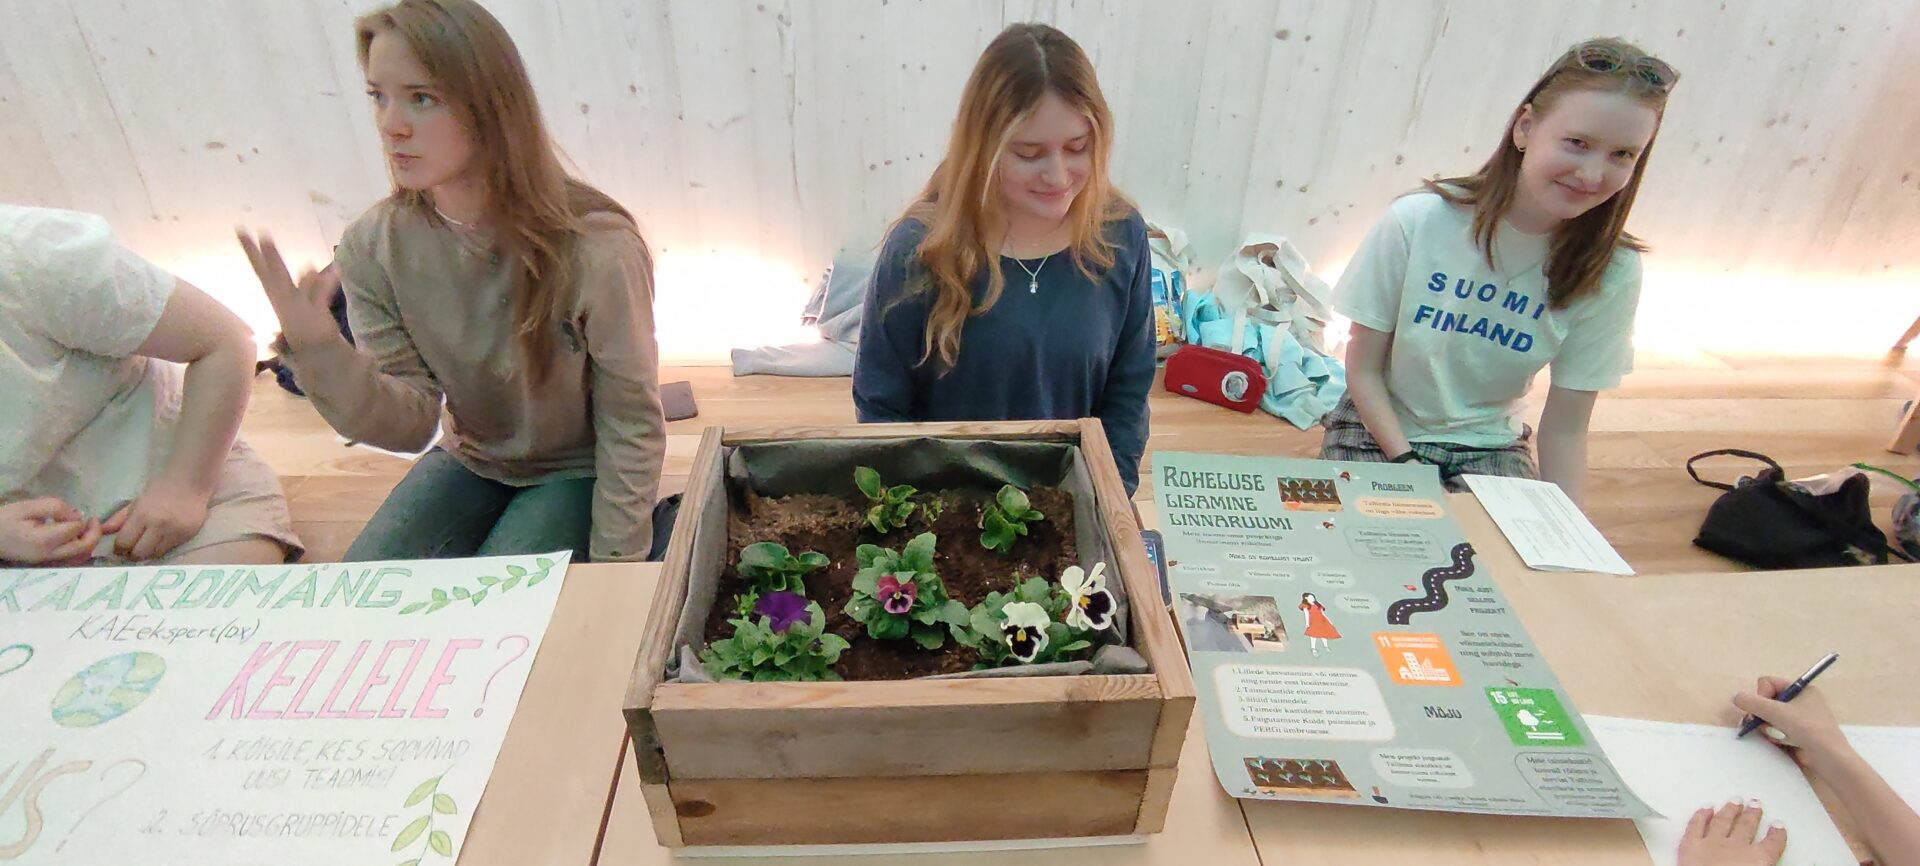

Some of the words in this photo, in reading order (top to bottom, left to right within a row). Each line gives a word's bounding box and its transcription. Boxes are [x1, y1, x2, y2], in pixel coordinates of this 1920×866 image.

[1428, 272, 1545, 320] SUOMI
[1413, 304, 1534, 353] FINLAND
[1163, 466, 1266, 491] ROHELUSE
[1371, 481, 1414, 492] PROBLEEM
[1166, 494, 1258, 511] LISAMINE
[1169, 513, 1293, 530] LINNARUUMI
[0, 565, 413, 612] KAARDIMÄNG
[204, 635, 530, 721] KELLELE?
[1490, 690, 1509, 705] 15
[312, 737, 371, 762] KES
[240, 767, 290, 791] UUSI
[299, 765, 396, 791] TEADMISI
